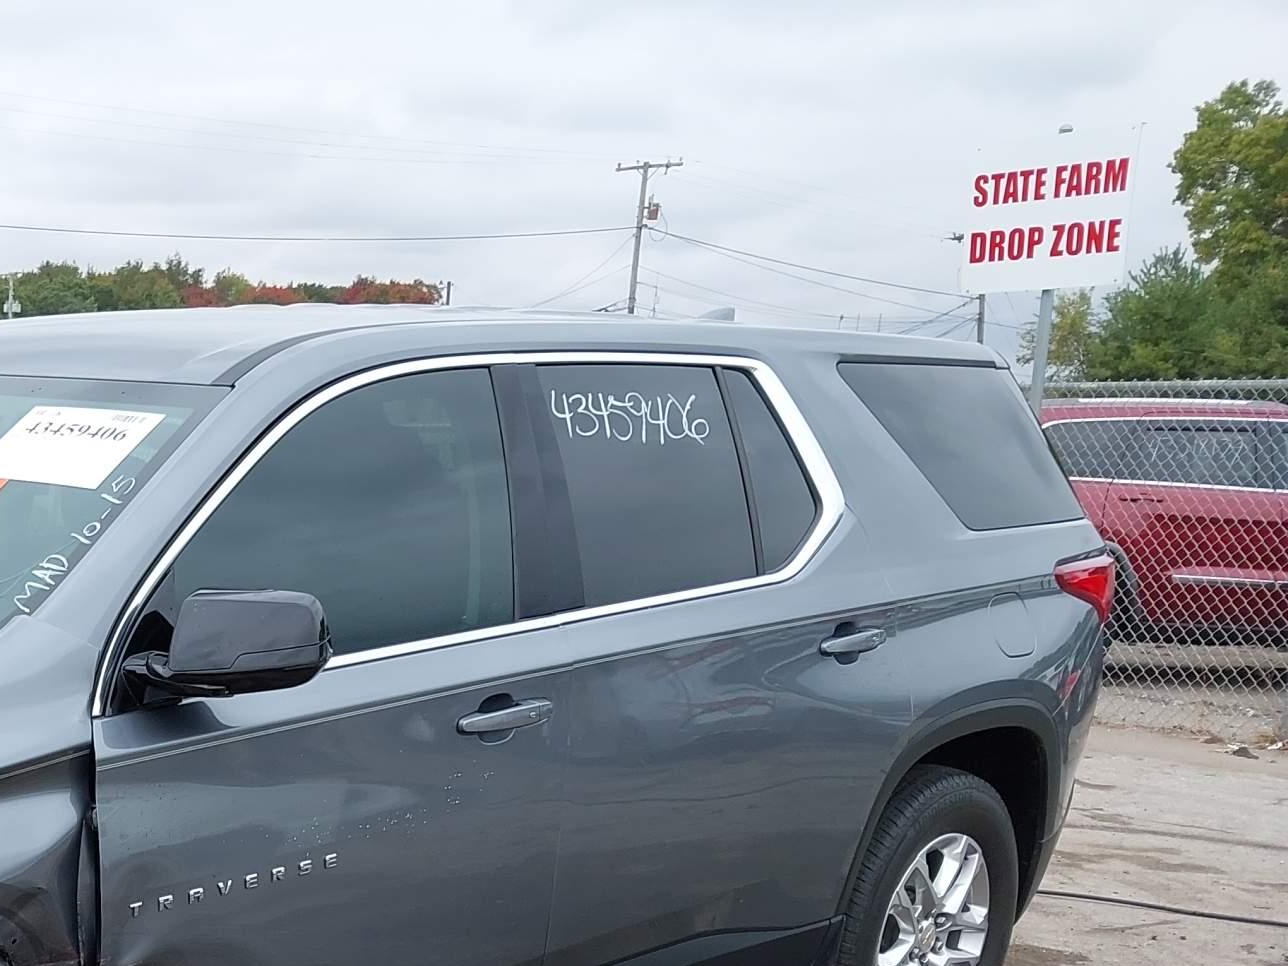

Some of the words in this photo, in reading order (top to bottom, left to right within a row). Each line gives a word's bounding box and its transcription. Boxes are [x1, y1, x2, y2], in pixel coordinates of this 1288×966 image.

[972, 167, 1049, 208] STATE
[1052, 156, 1131, 199] FARM
[968, 226, 1045, 264] DROP
[1048, 217, 1123, 258] ZONE
[24, 421, 129, 442] 43459406
[550, 389, 710, 446] 43459406
[13, 553, 69, 613] MAD
[69, 474, 137, 545] 10-15
[128, 852, 339, 918] TRAVERSE
